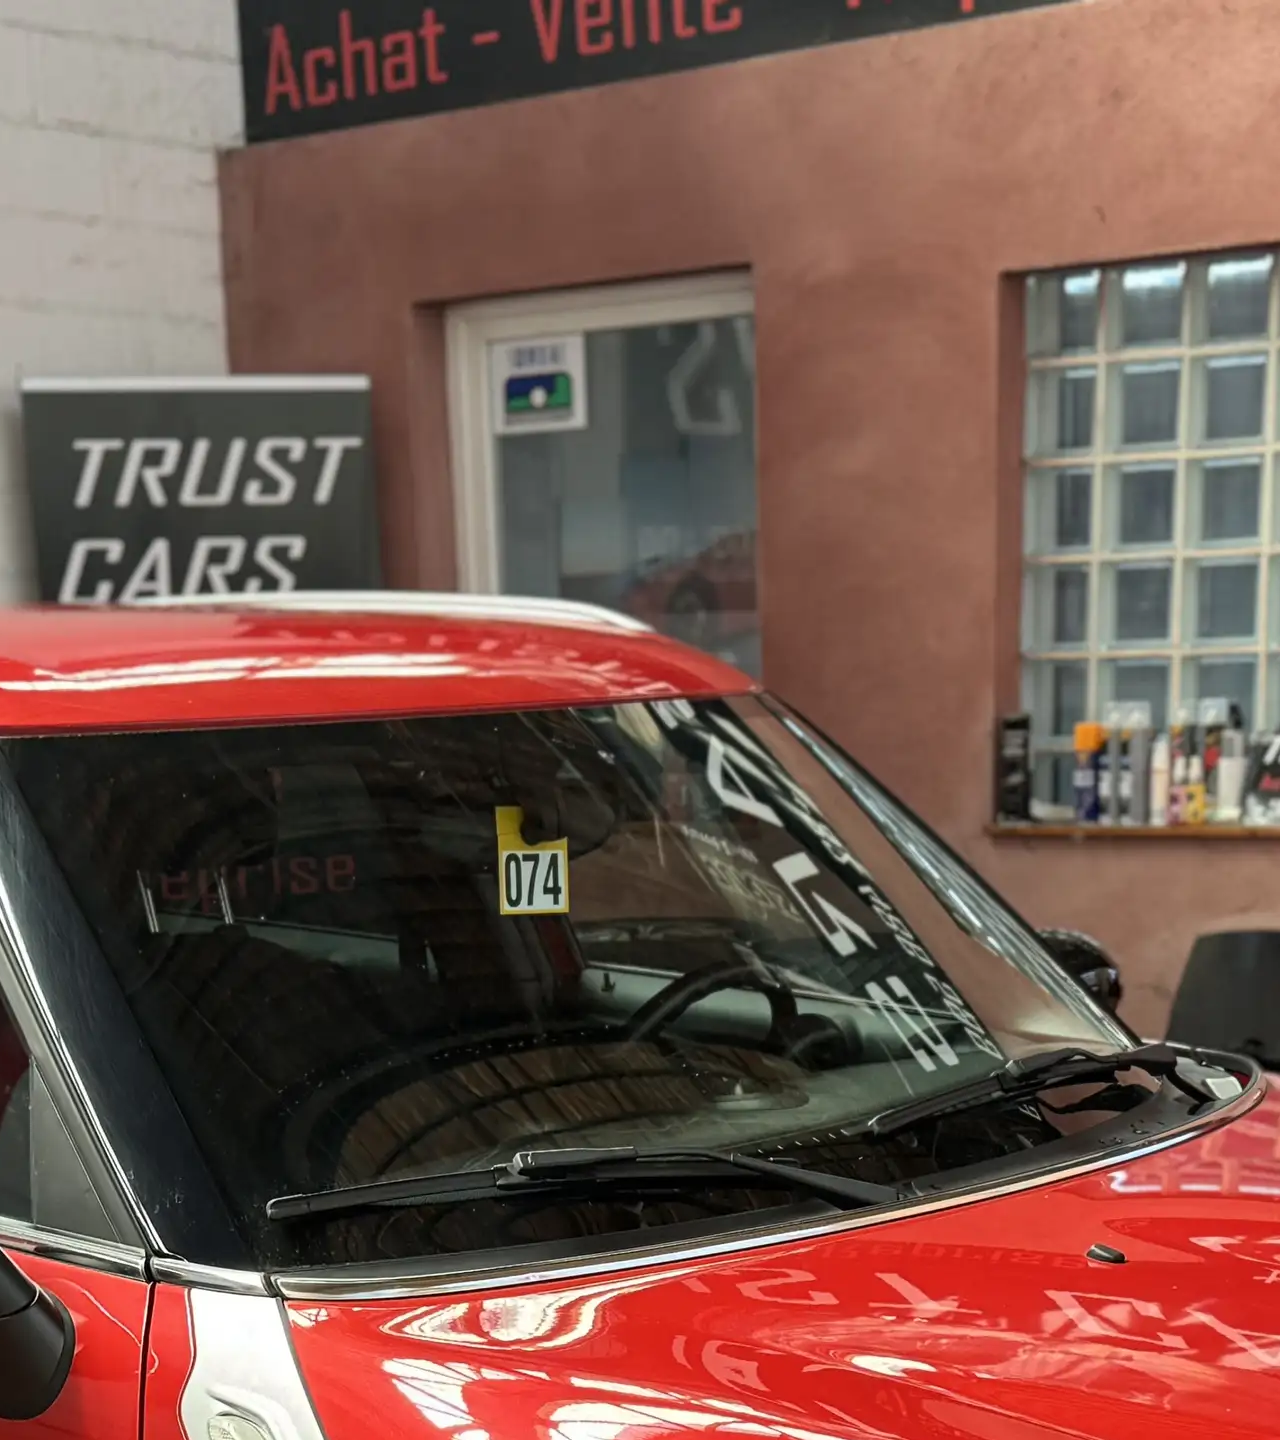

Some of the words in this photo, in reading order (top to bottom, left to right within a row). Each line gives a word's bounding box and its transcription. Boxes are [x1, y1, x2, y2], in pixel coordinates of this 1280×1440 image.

[265, 8, 448, 115] Achat
[72, 437, 363, 508] TRUST
[58, 535, 307, 604] CARS
[158, 854, 356, 914] eprise
[504, 852, 563, 908] 074
